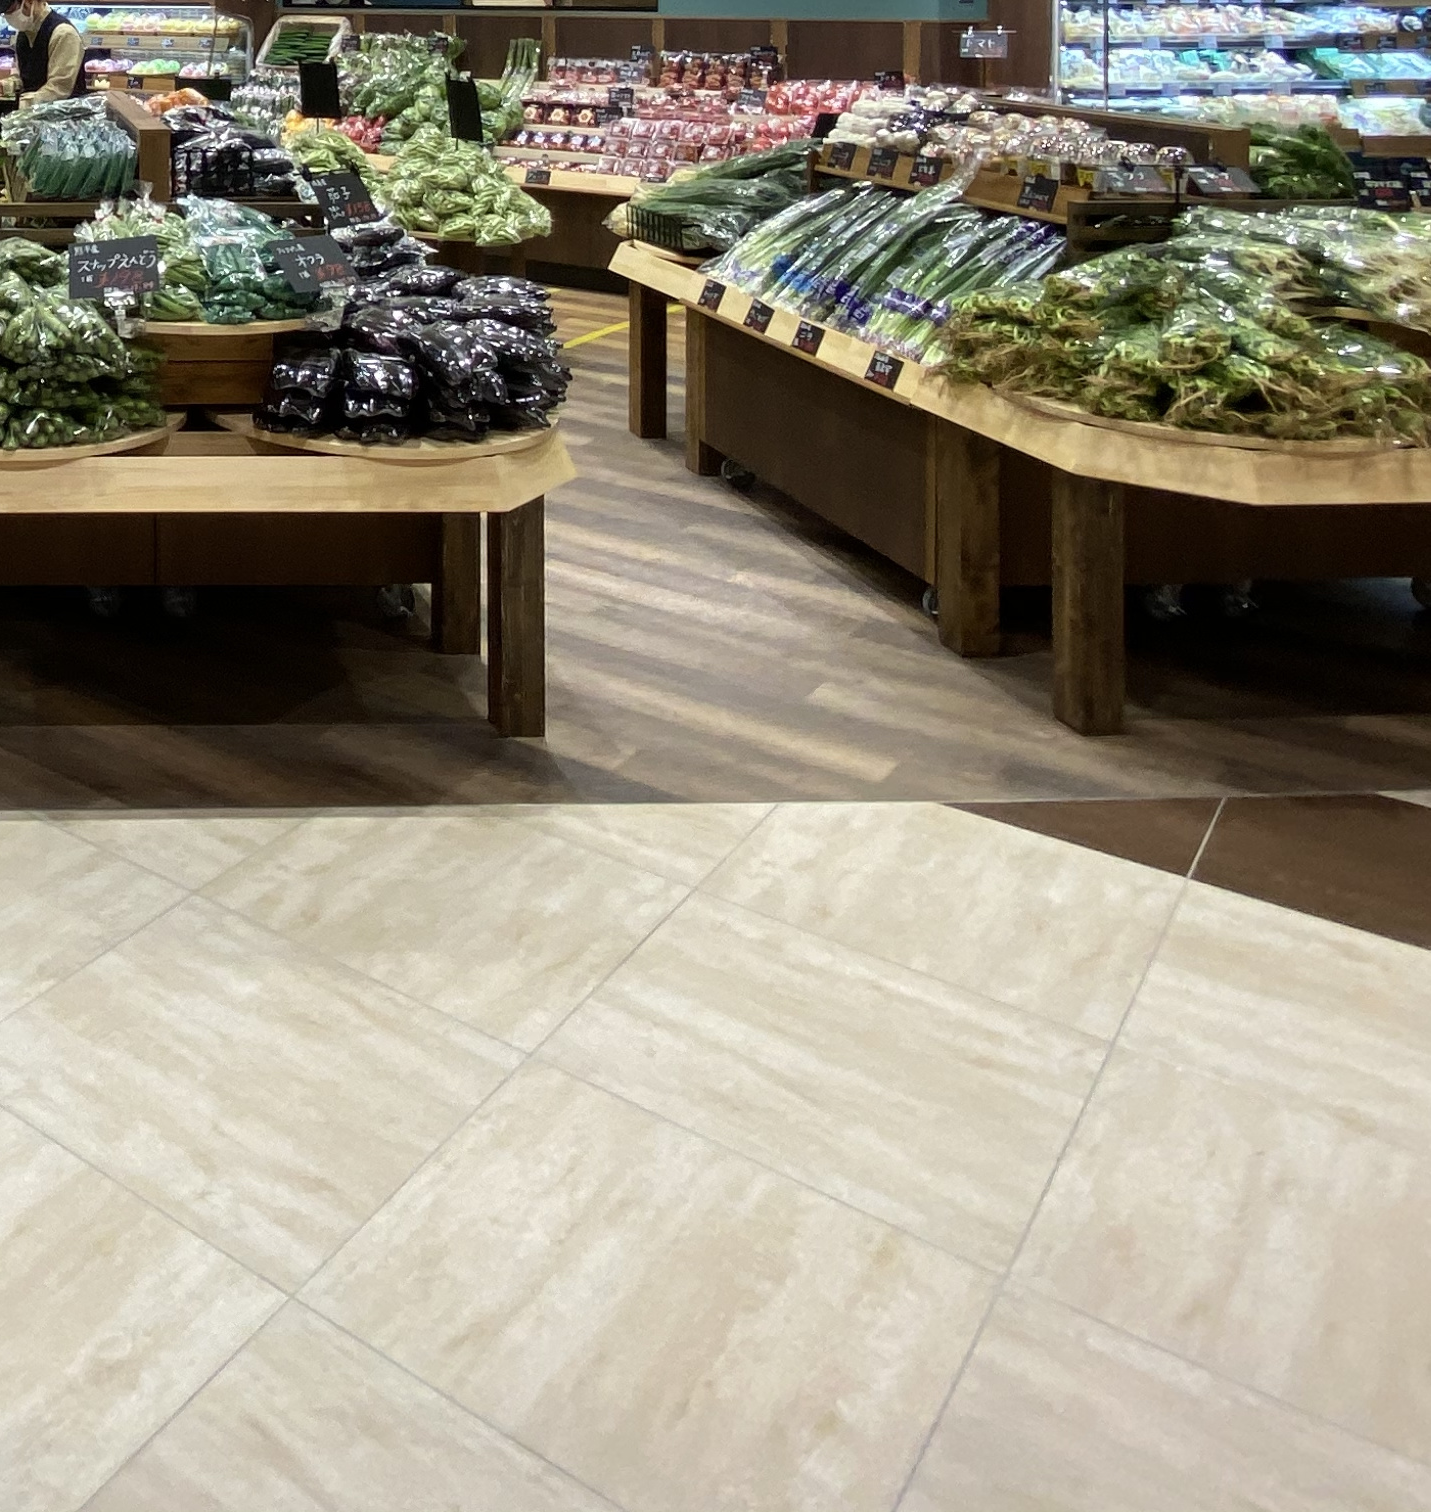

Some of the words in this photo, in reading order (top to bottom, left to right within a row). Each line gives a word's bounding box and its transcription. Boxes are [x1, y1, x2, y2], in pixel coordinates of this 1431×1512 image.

[77, 249, 157, 274] スナップえんどう
